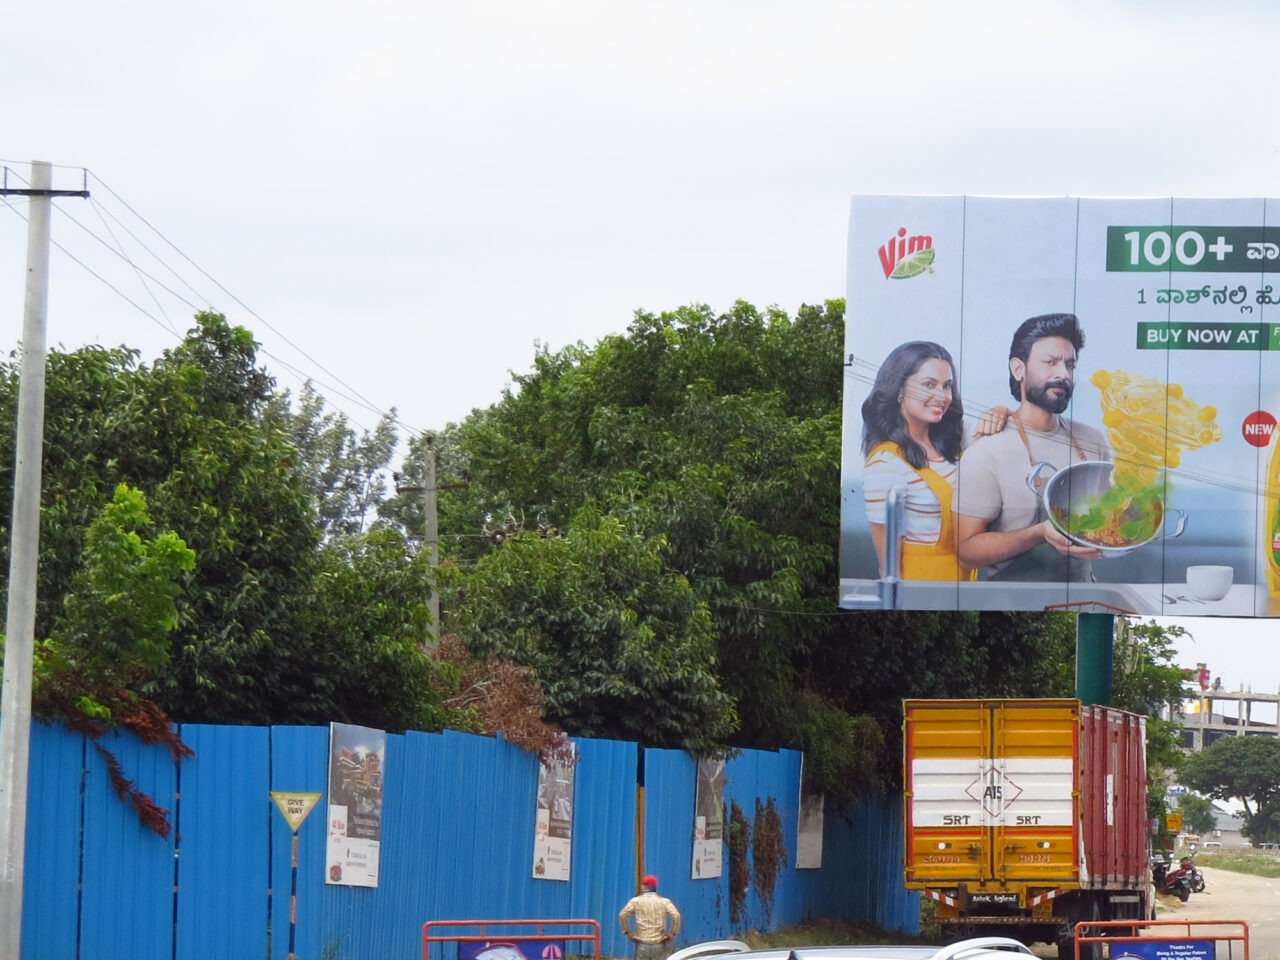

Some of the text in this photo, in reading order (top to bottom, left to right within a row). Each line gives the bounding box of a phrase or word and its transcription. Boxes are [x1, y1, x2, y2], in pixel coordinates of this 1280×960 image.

[878, 227, 932, 280] Vim
[1124, 231, 1233, 266] 100+
[1137, 288, 1147, 305] 1
[1147, 328, 1259, 343] BUY NOW AT
[1245, 423, 1273, 435] NEW
[943, 815, 971, 825] SRT
[1016, 815, 1042, 825] SRT
[1019, 855, 1050, 863] HORN
